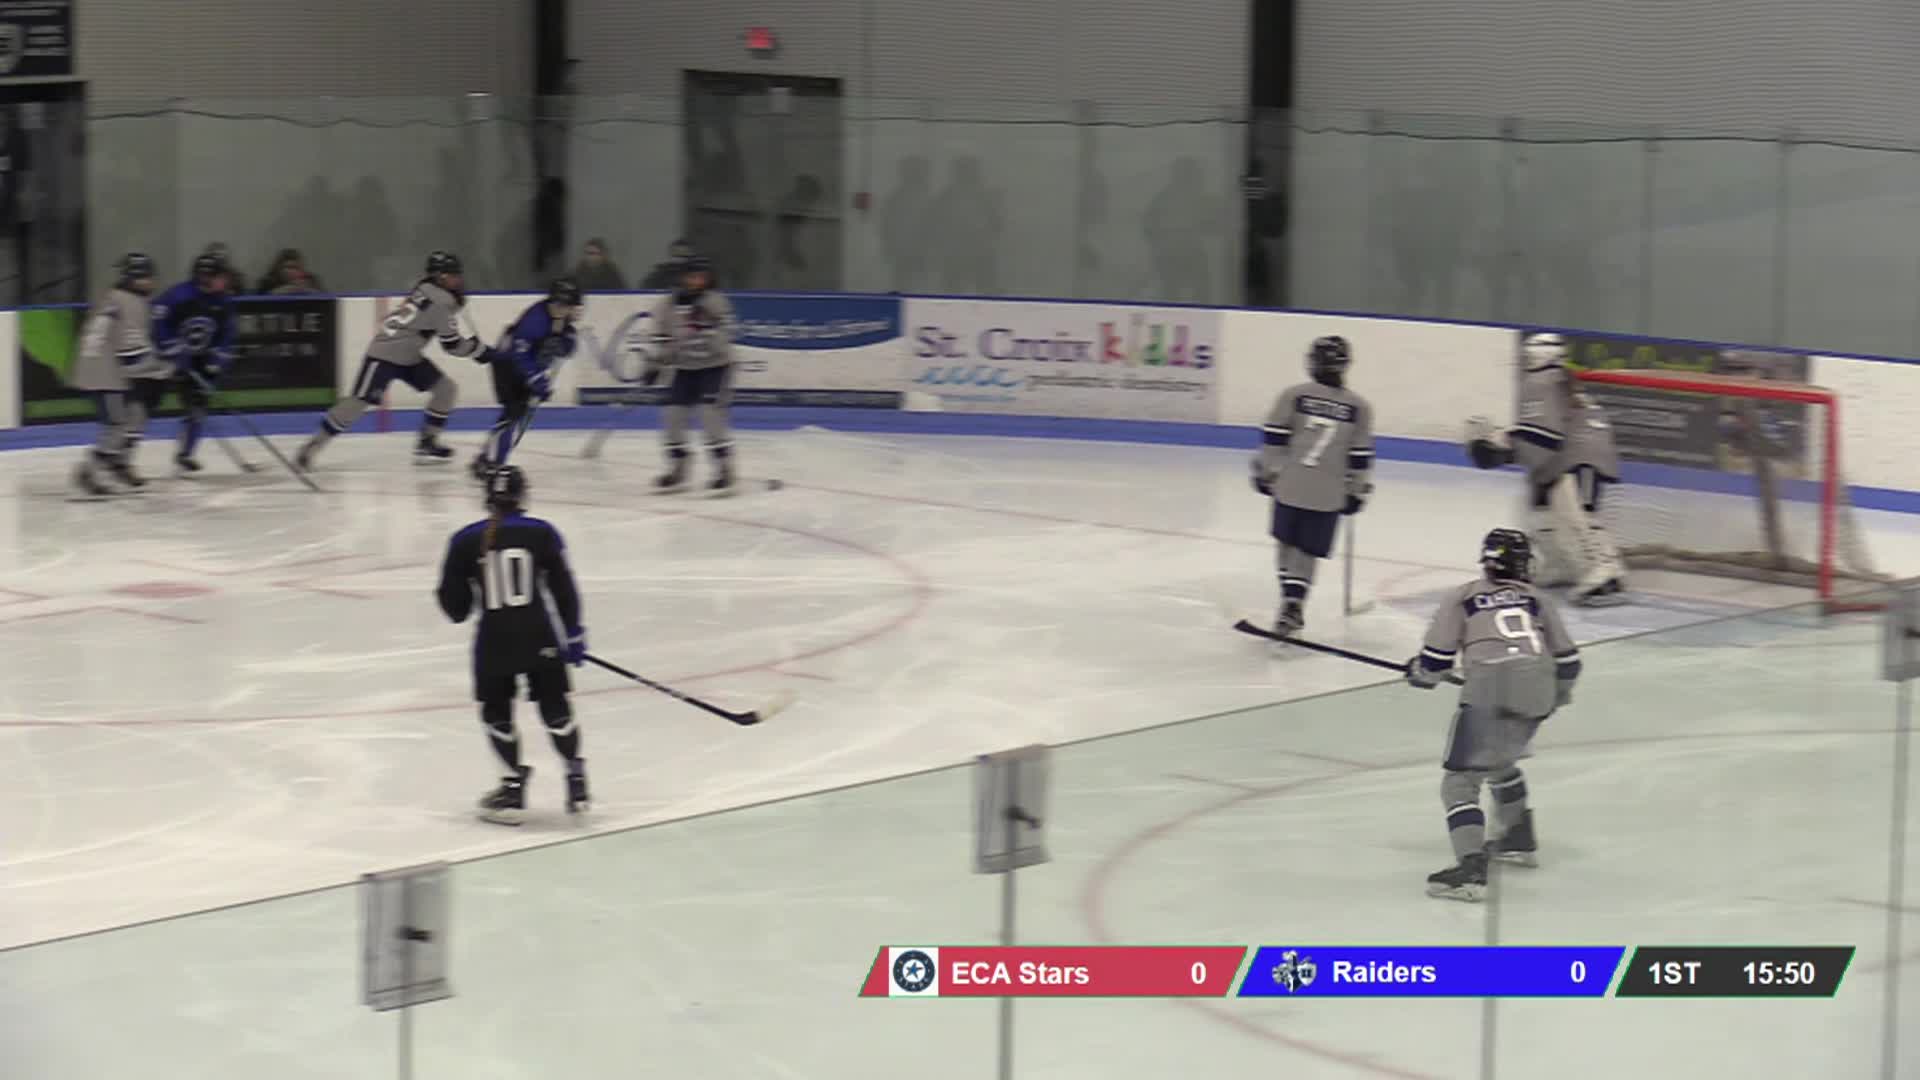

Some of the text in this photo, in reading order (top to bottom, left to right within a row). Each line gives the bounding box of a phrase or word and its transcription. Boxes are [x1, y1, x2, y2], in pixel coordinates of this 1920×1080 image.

[1304, 416, 1337, 467] 7
[477, 548, 533, 610] 10
[1495, 607, 1542, 655] 9
